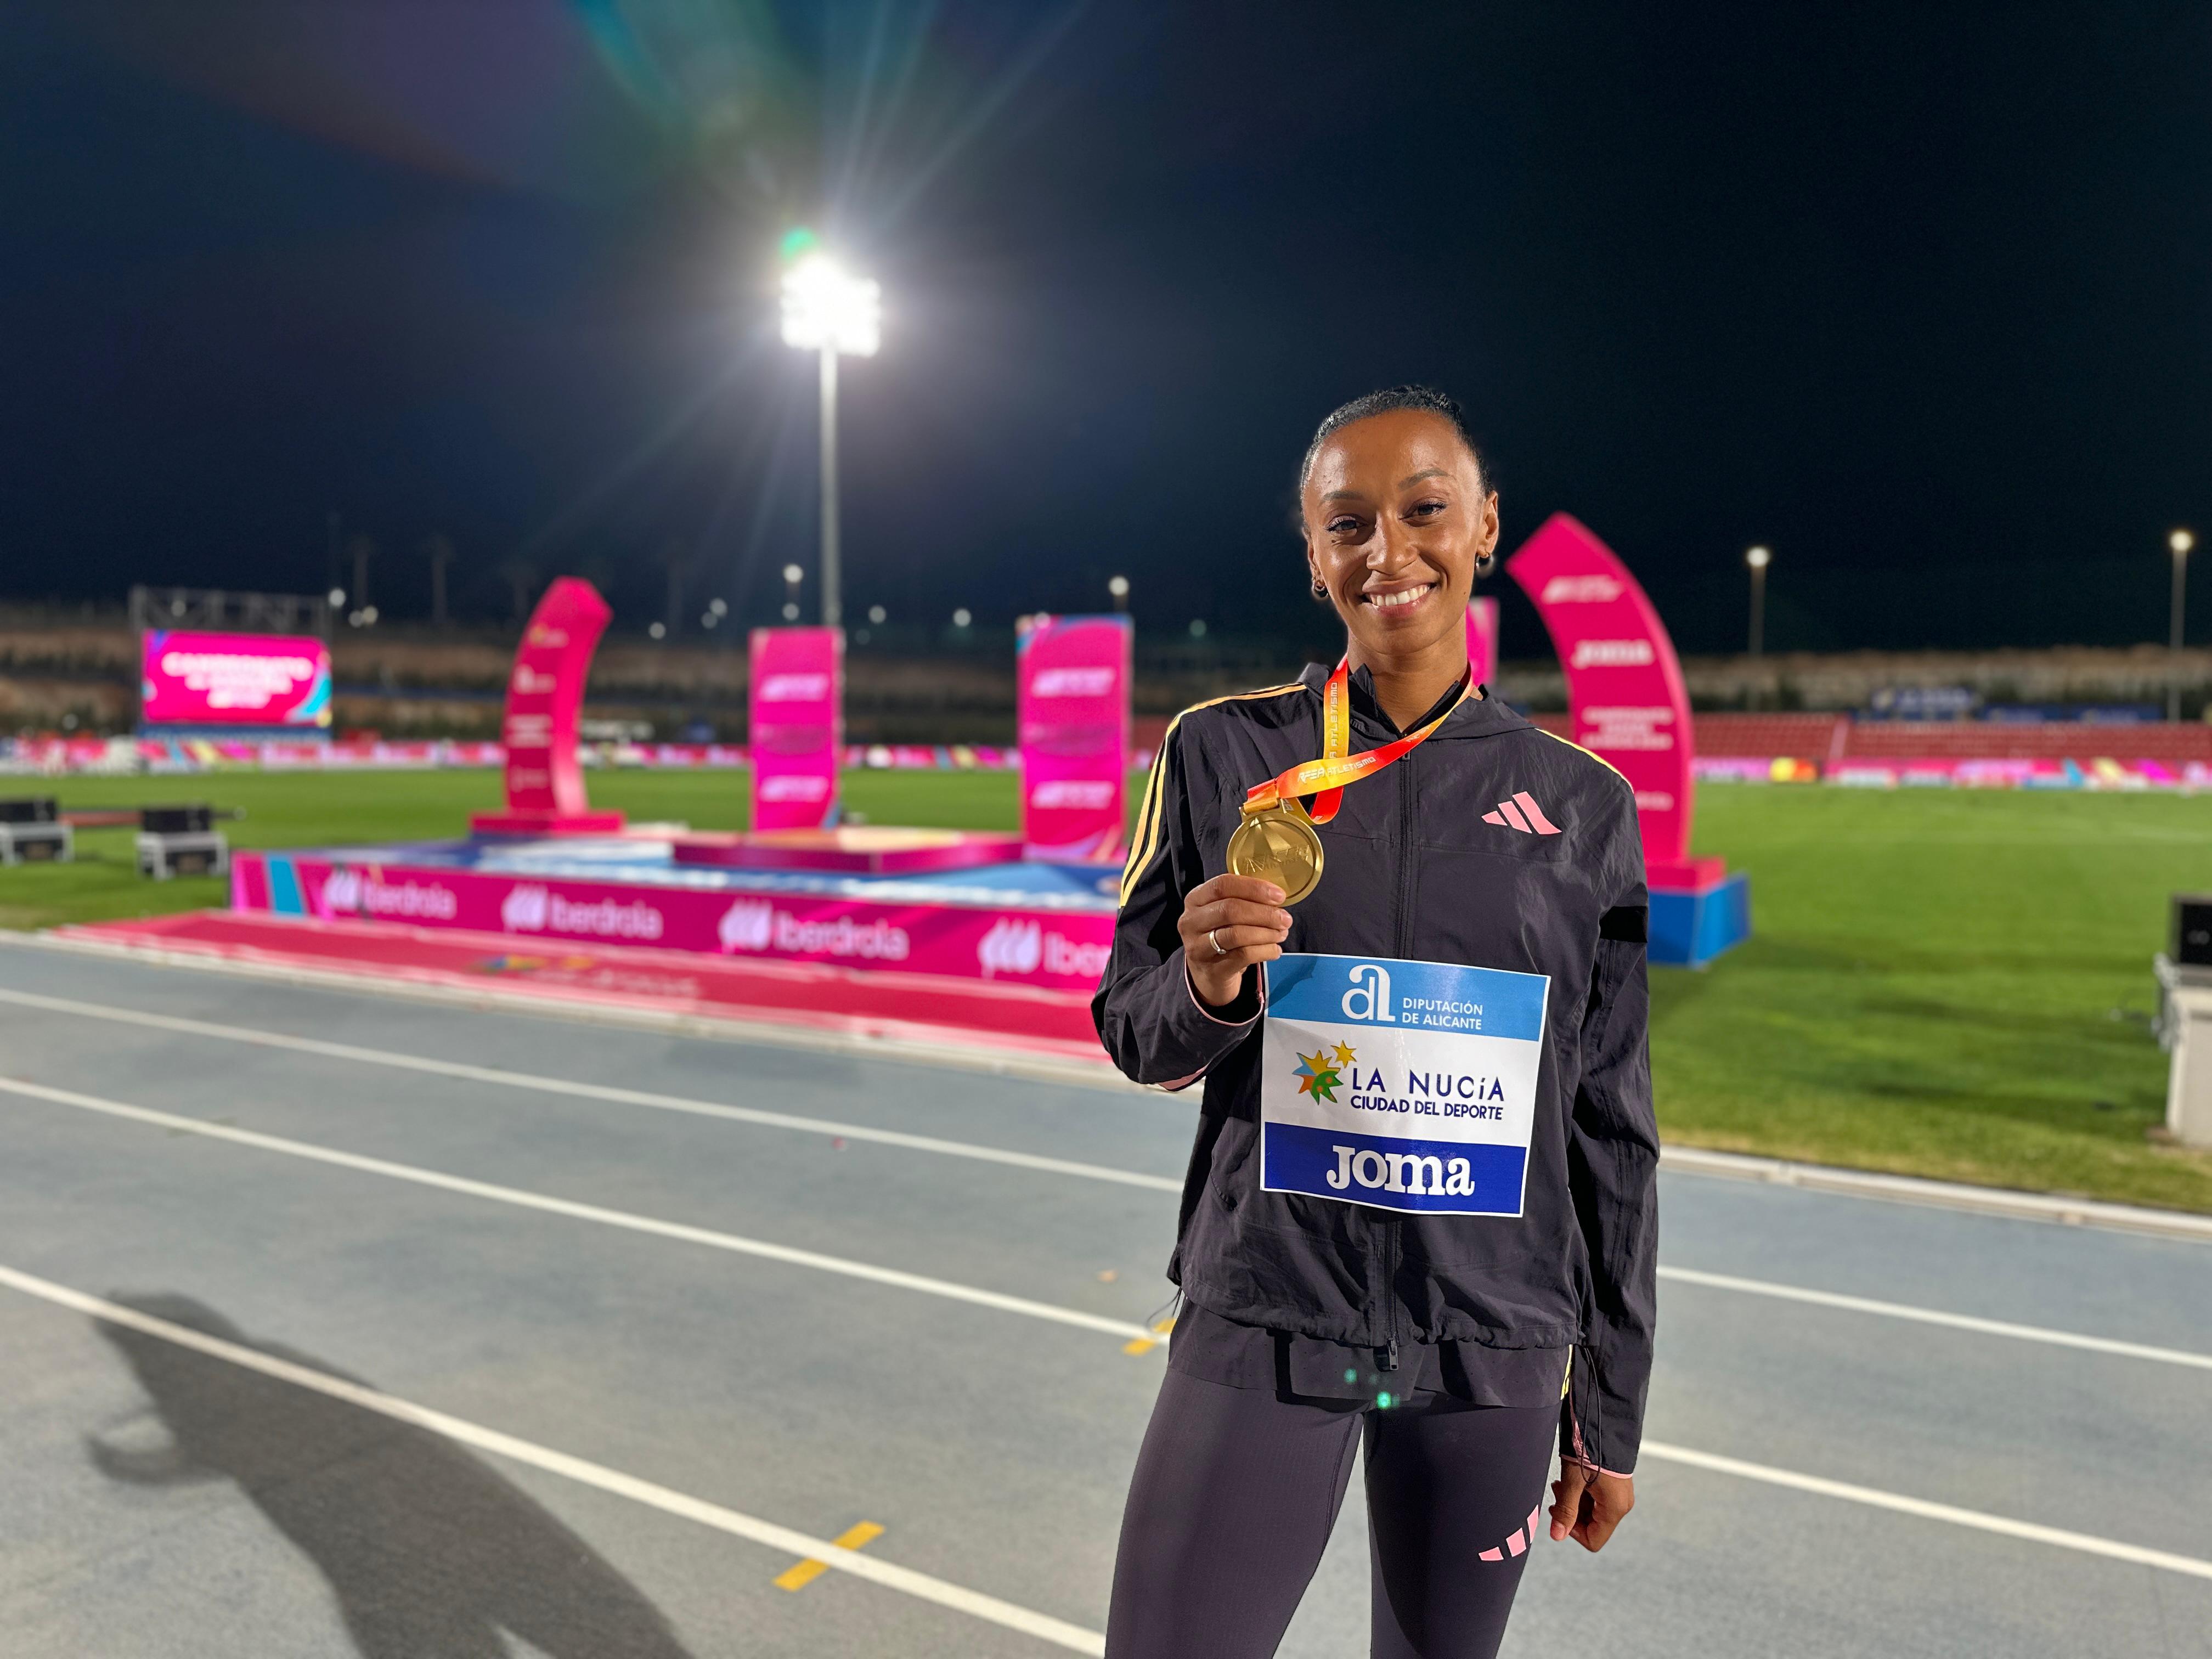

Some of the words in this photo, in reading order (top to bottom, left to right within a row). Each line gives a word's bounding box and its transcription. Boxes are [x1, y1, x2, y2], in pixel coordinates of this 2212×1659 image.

[1297, 767, 1325, 784] RFEA
[1328, 757, 1377, 778] ATLETISMO
[1403, 997, 1483, 1015] DIPUTACIÓN
[1402, 1013, 1419, 1024] DE
[1423, 1014, 1482, 1030] ALICANTE
[1353, 1068, 1386, 1092] LA
[1351, 1095, 1410, 1113] CIUDAD
[1414, 1101, 1440, 1115] DEL
[1444, 1103, 1503, 1120] DEPORTE
